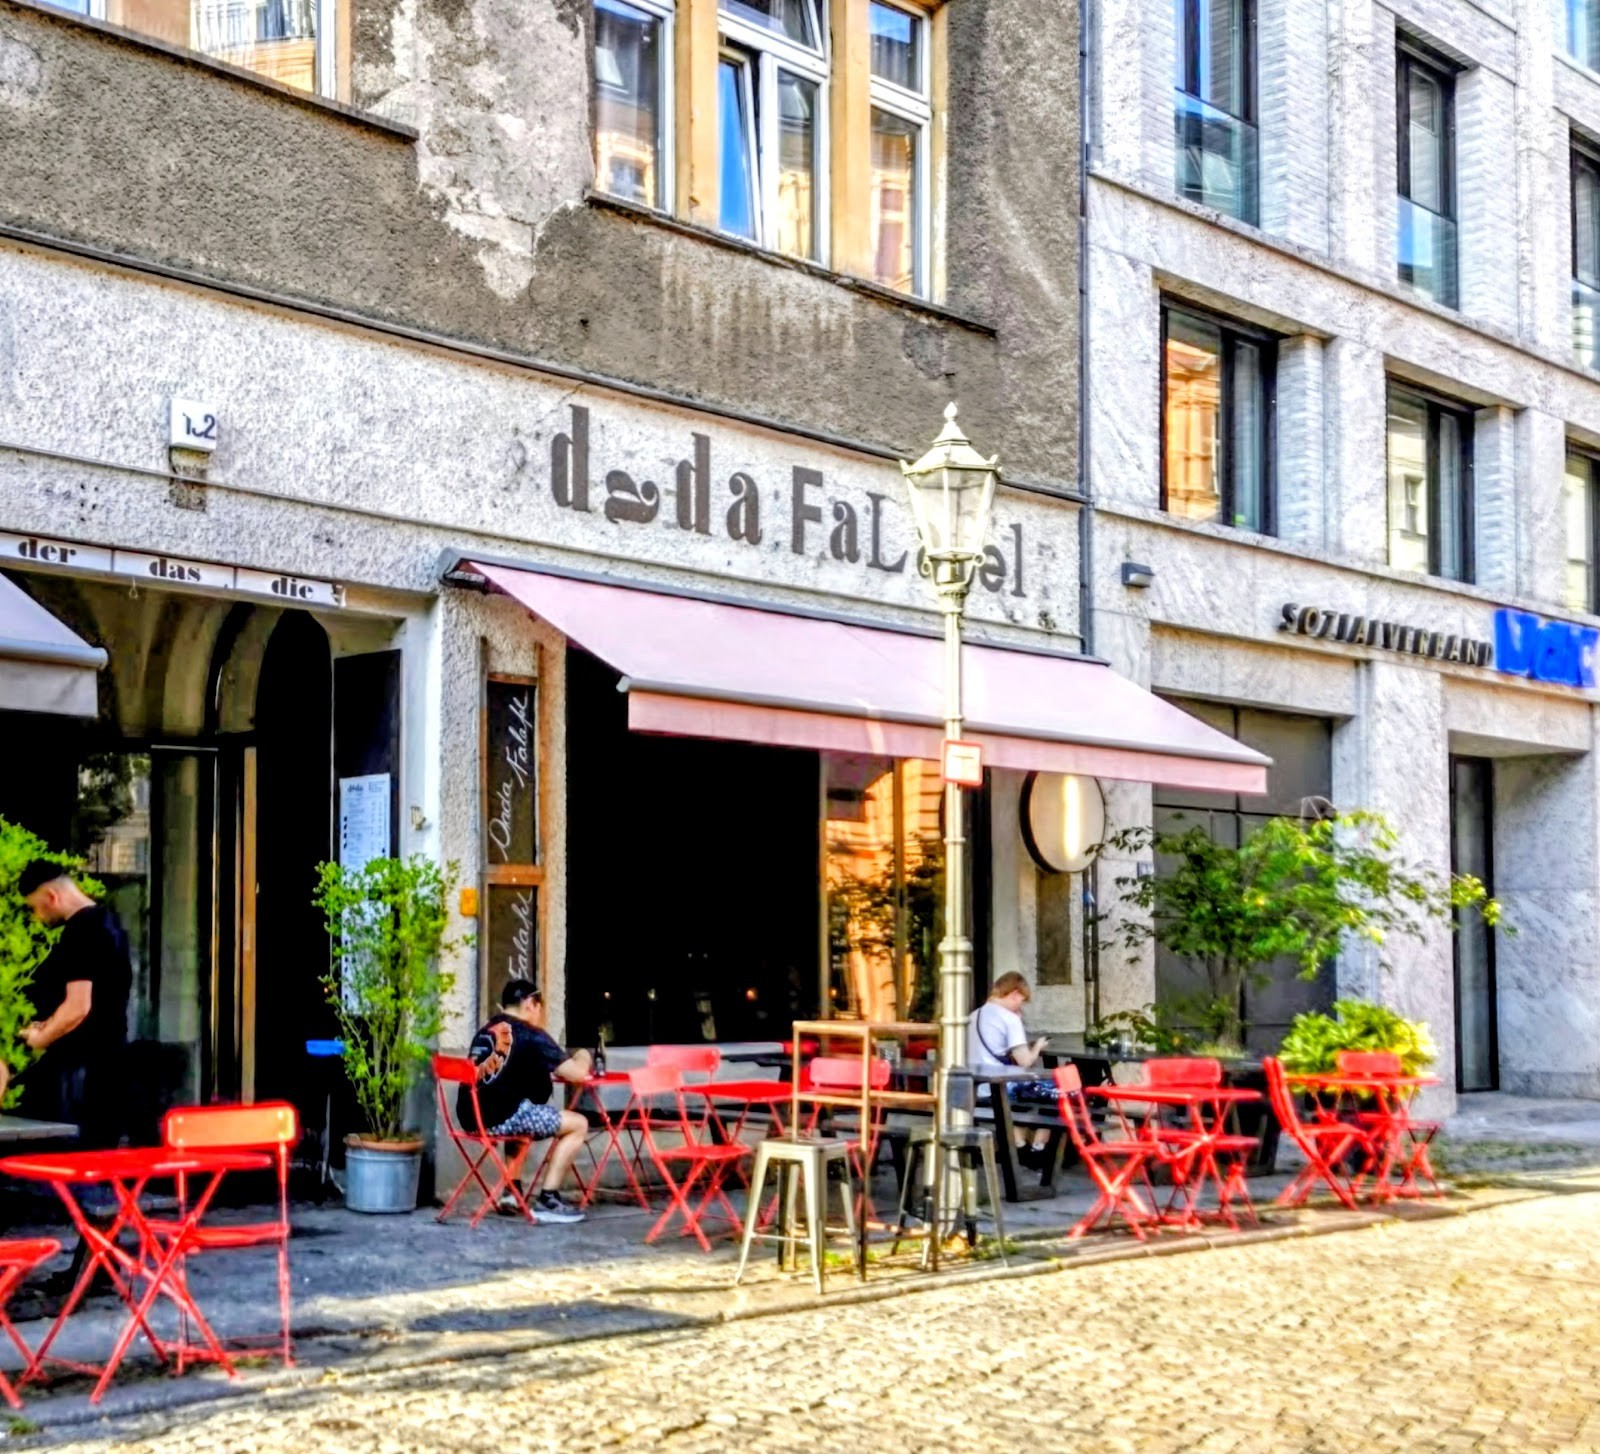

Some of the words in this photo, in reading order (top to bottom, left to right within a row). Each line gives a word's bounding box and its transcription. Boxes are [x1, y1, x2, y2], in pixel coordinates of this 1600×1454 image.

[17, 539, 77, 563] der
[149, 559, 202, 583] das
[270, 577, 314, 600] die
[792, 465, 1027, 598] FaLel
